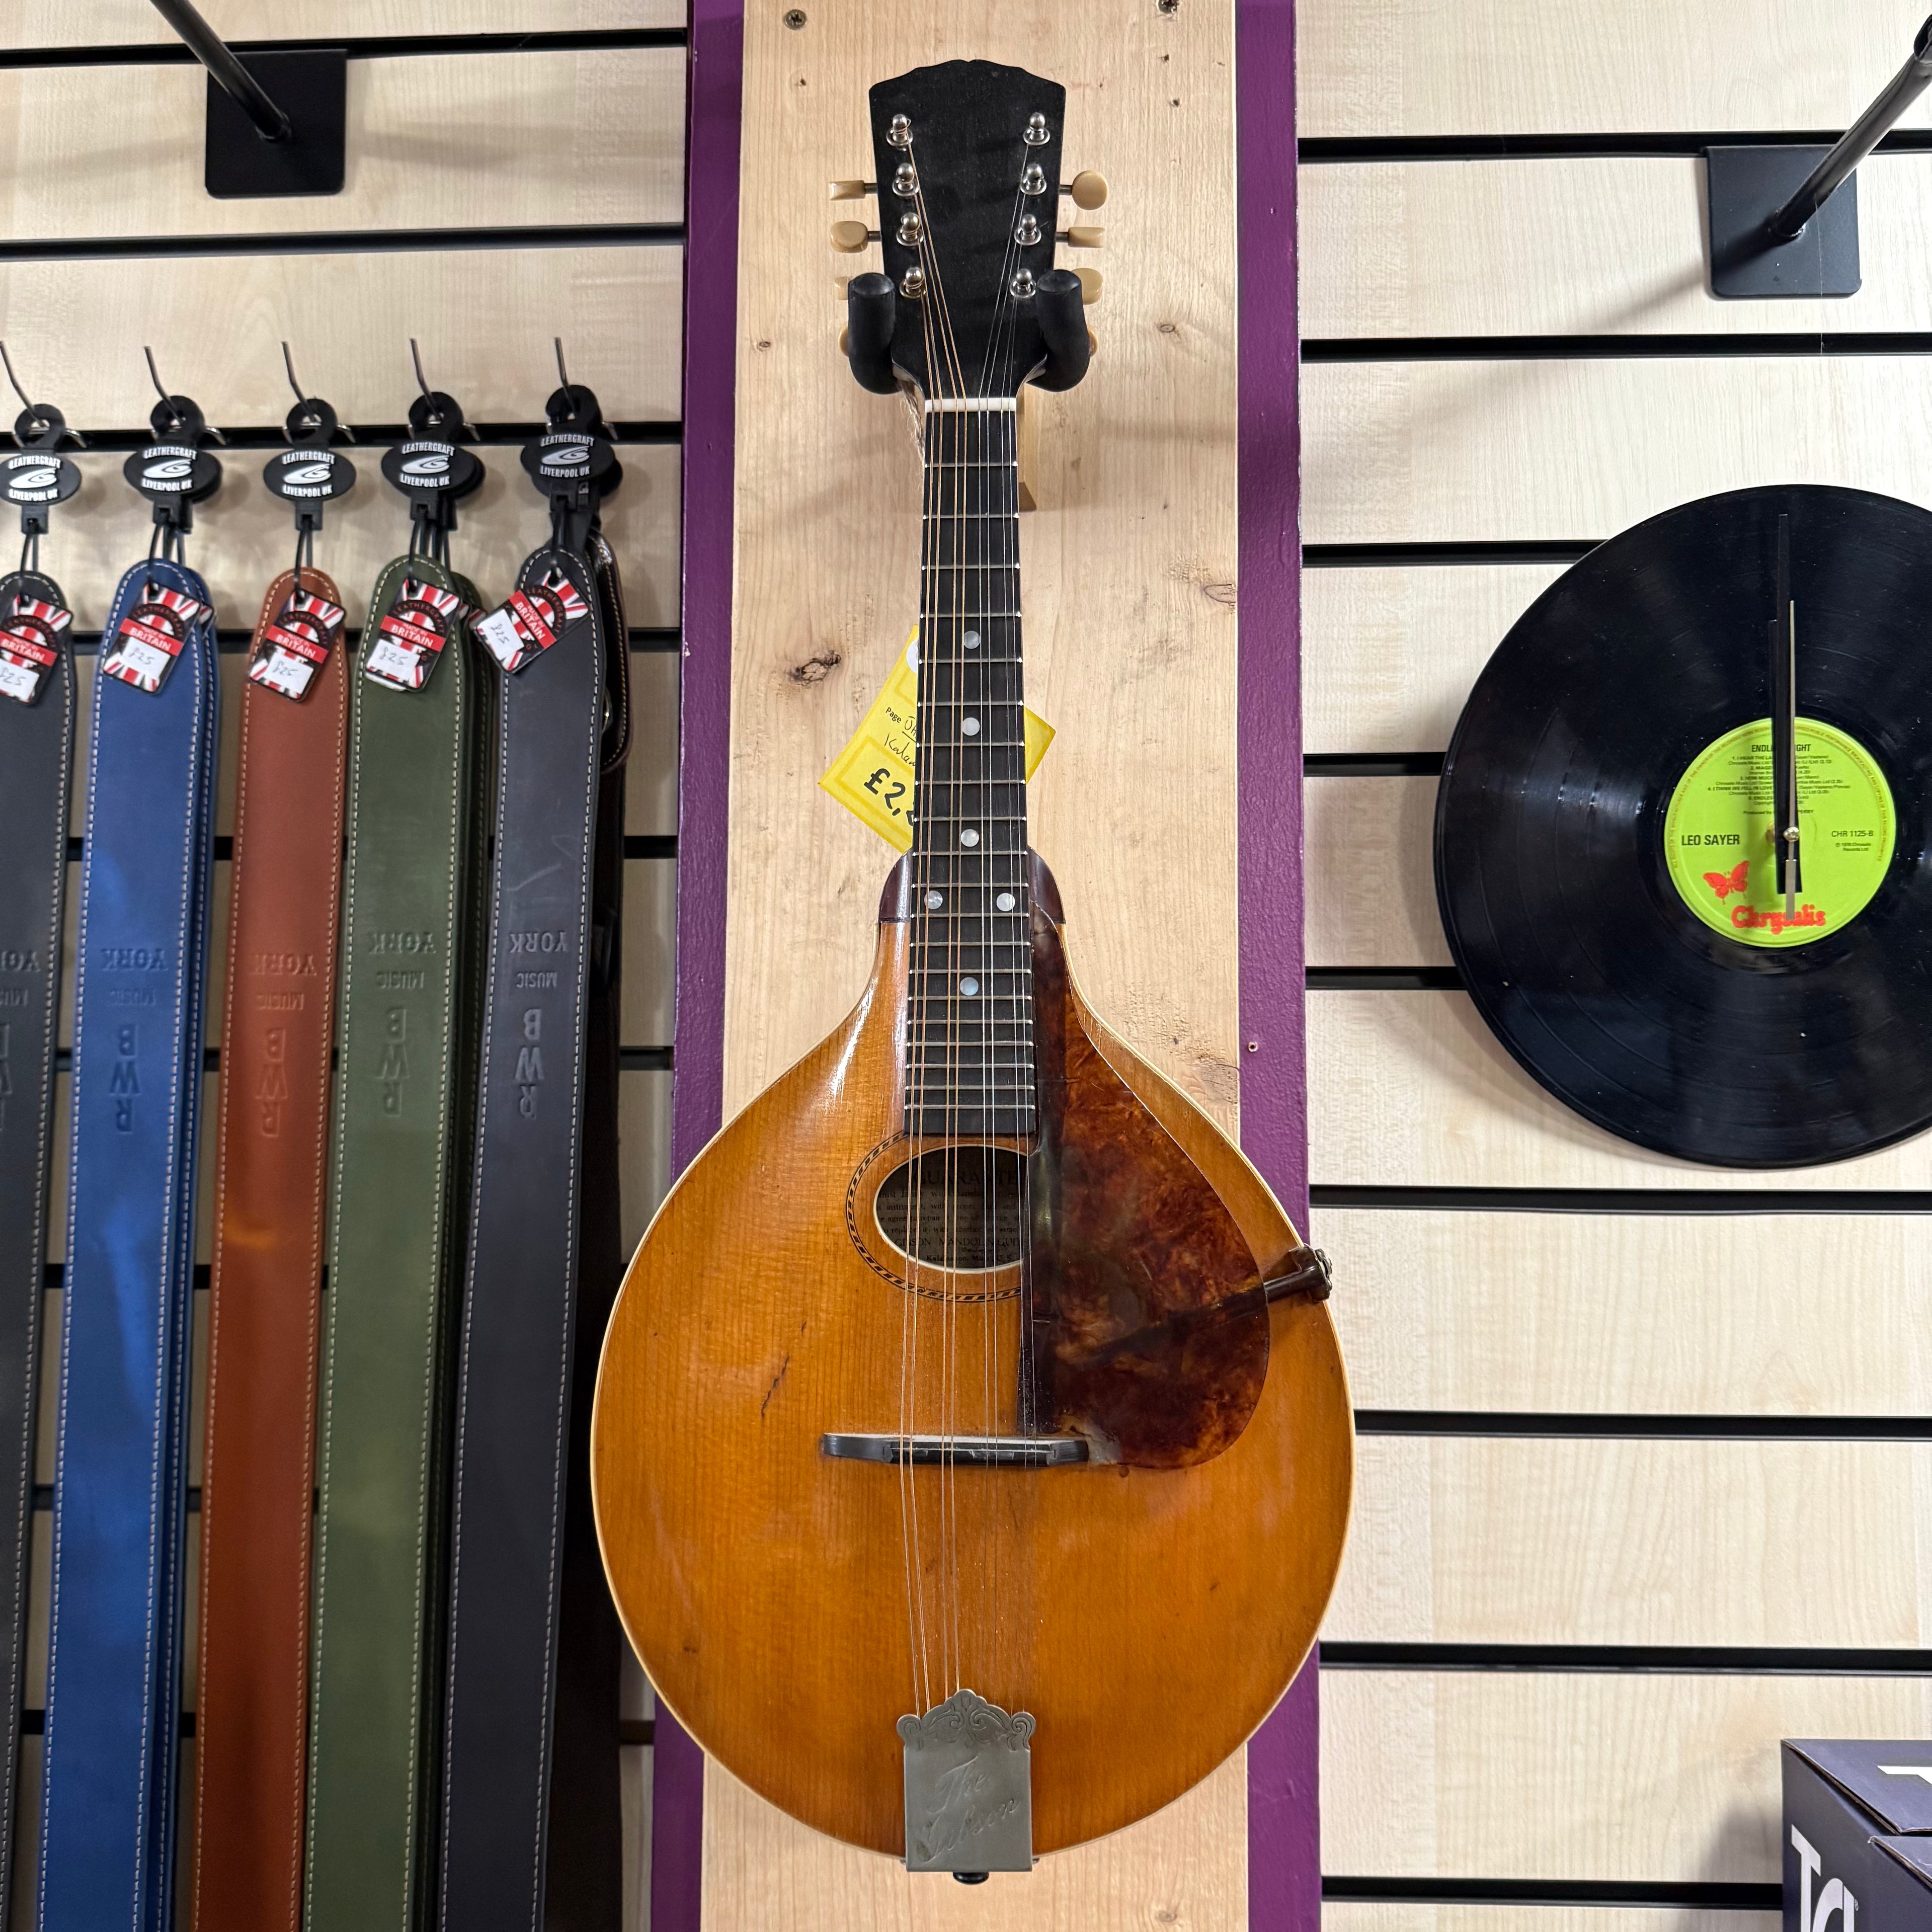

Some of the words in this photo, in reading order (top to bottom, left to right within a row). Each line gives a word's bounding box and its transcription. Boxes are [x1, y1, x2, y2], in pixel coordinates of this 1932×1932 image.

[540, 434, 594, 447] LEATHERCRAFT
[143, 446, 197, 460] LEATHERCRAFT
[402, 442, 455, 456] LEATHERCRAFT
[8, 455, 61, 469] LEATHERCRAFT
[282, 451, 335, 464] LEATHERCRAFT
[540, 465, 579, 478] LIVERPOOL
[580, 466, 590, 476] UK
[141, 478, 181, 492] LIVERPOOL
[181, 479, 192, 490] UK
[399, 473, 438, 488] LIVERPOOL
[439, 476, 449, 486] UK
[9, 489, 47, 501] LIVERPOOL
[47, 489, 57, 499] UK
[282, 485, 321, 498] LIVERPOOL
[321, 485, 332, 495] UK
[516, 602, 545, 639] BRITAIN
[129, 627, 172, 651] BRITAIN
[391, 624, 434, 647] BRITAIN
[2, 638, 45, 661] BRITAIN
[276, 634, 316, 658] BRITAIN
[886, 707, 902, 723] Page
[1681, 835, 1701, 846] LEO
[1704, 834, 1740, 846] SAYER
[369, 932, 437, 954] YORK
[509, 932, 569, 953] YORK
[516, 972, 557, 988] MUSIC
[927, 1753, 990, 1814] The
